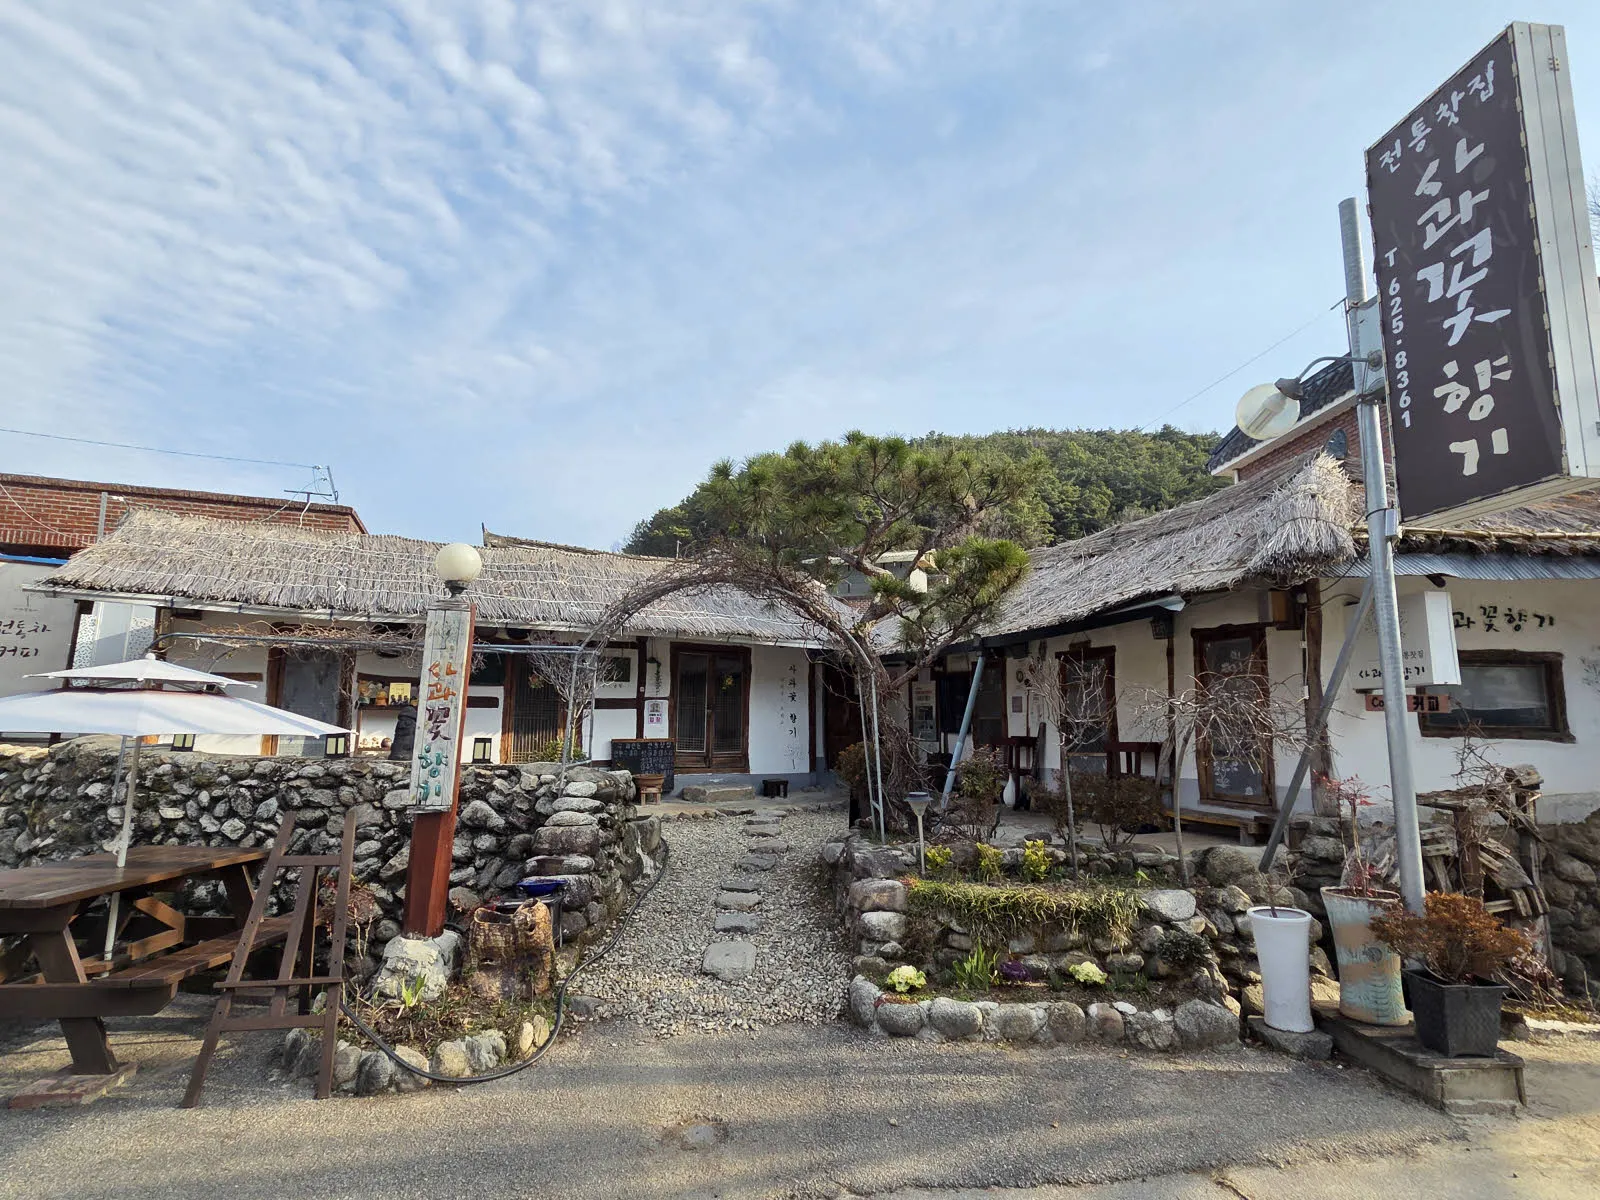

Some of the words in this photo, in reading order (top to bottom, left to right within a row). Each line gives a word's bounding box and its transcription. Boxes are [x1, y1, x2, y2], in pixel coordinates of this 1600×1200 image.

[1379, 60, 1495, 173] 전통찻집
[1415, 138, 1512, 476] 사과꽃향기
[1453, 606, 1555, 632] 과꽃향기
[1359, 666, 1425, 681] 사과향기
[1402, 650, 1424, 660] 통찻집
[418, 661, 458, 801] 사과꽃향기
